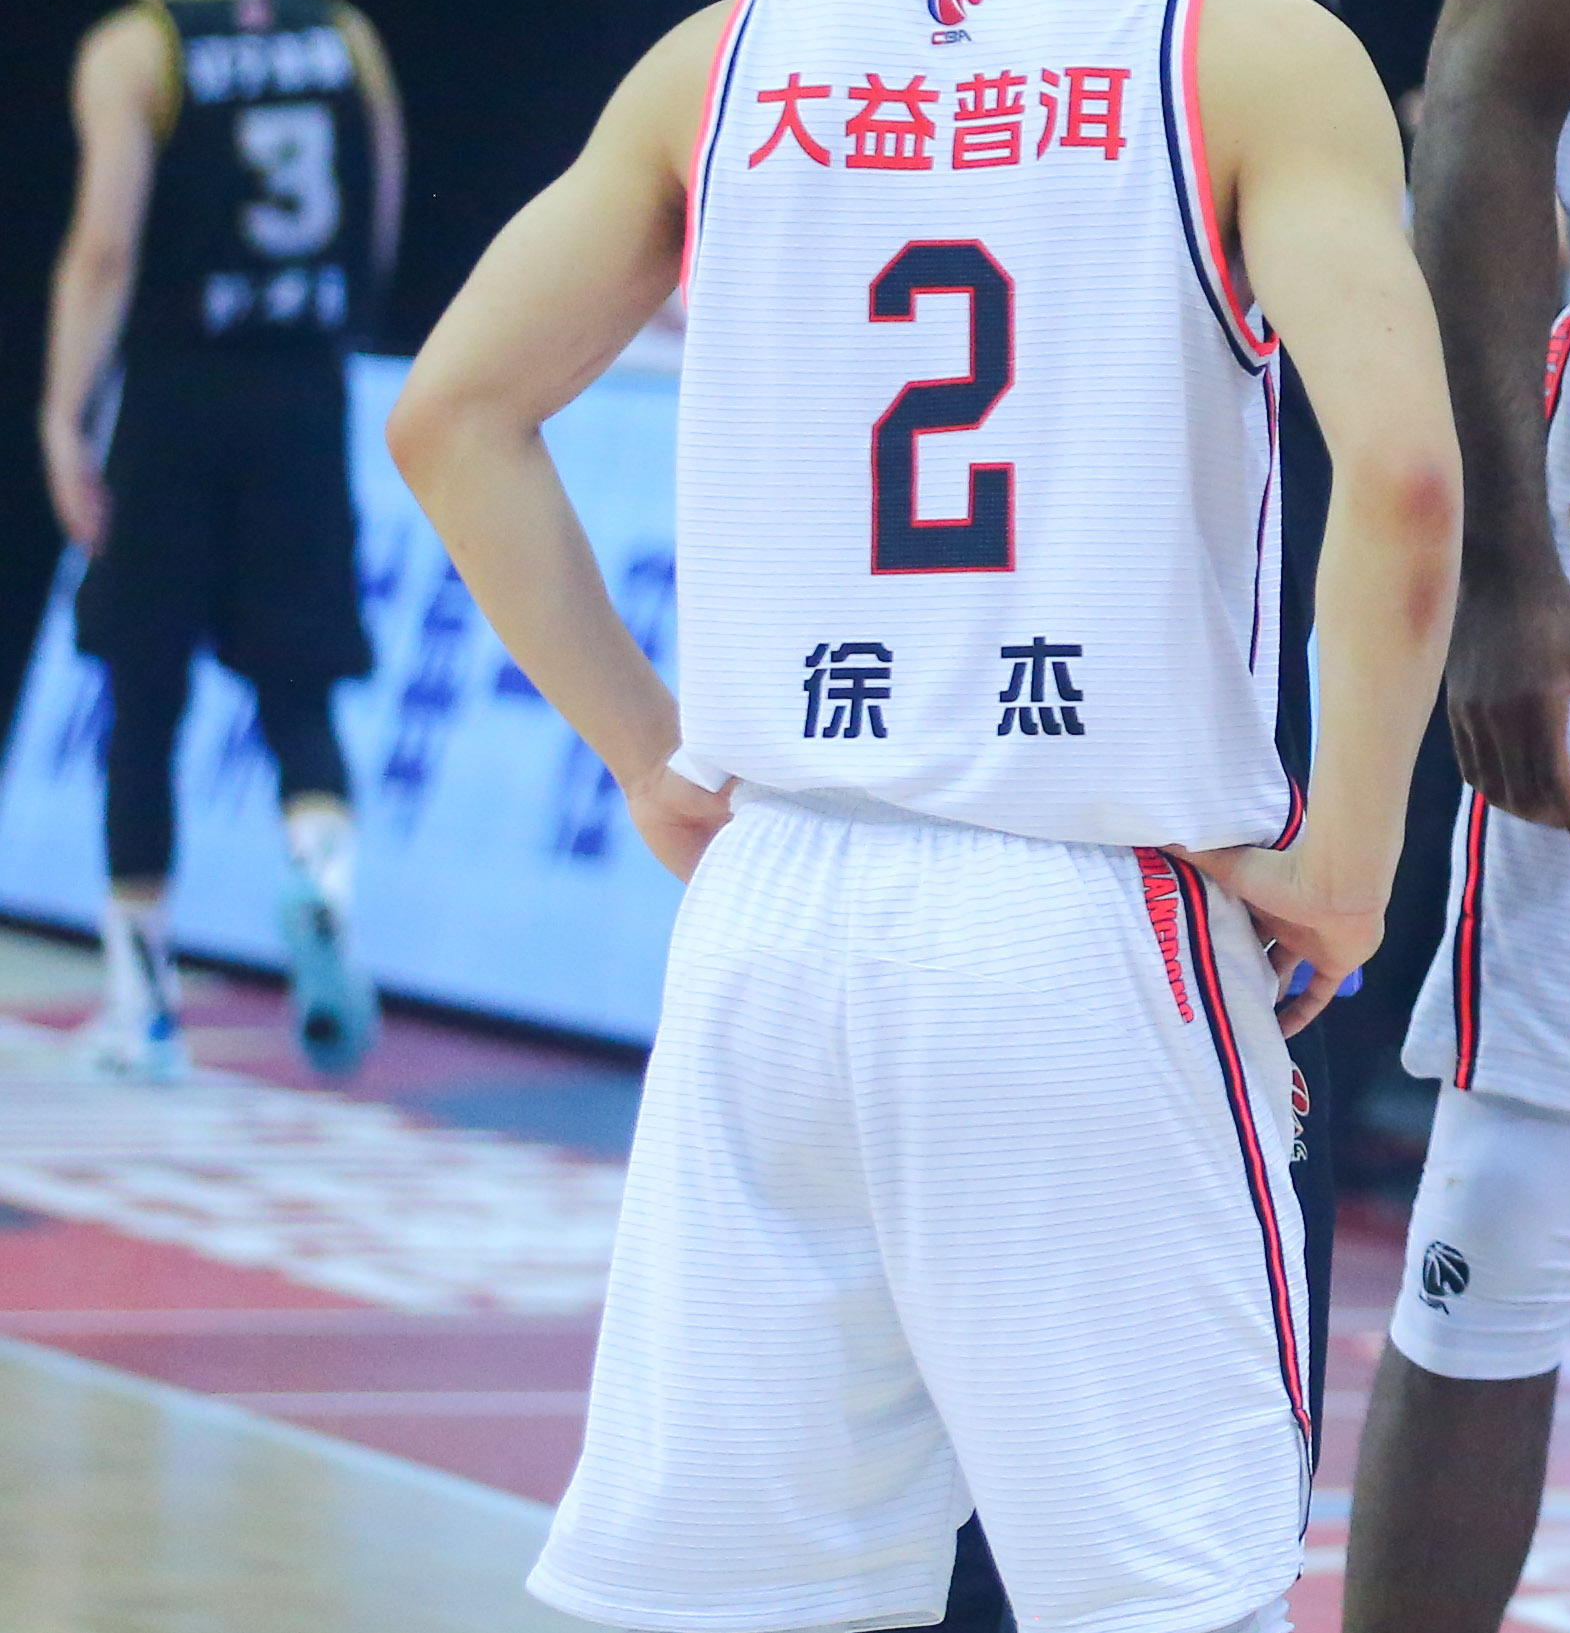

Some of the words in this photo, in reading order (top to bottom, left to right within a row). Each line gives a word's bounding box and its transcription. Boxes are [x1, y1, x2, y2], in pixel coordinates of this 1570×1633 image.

[931, 29, 972, 45] CBA
[748, 67, 1132, 171] 大益普洱
[233, 102, 342, 258] 3
[868, 239, 1016, 575] 2
[804, 636, 1086, 740] 徐杰
